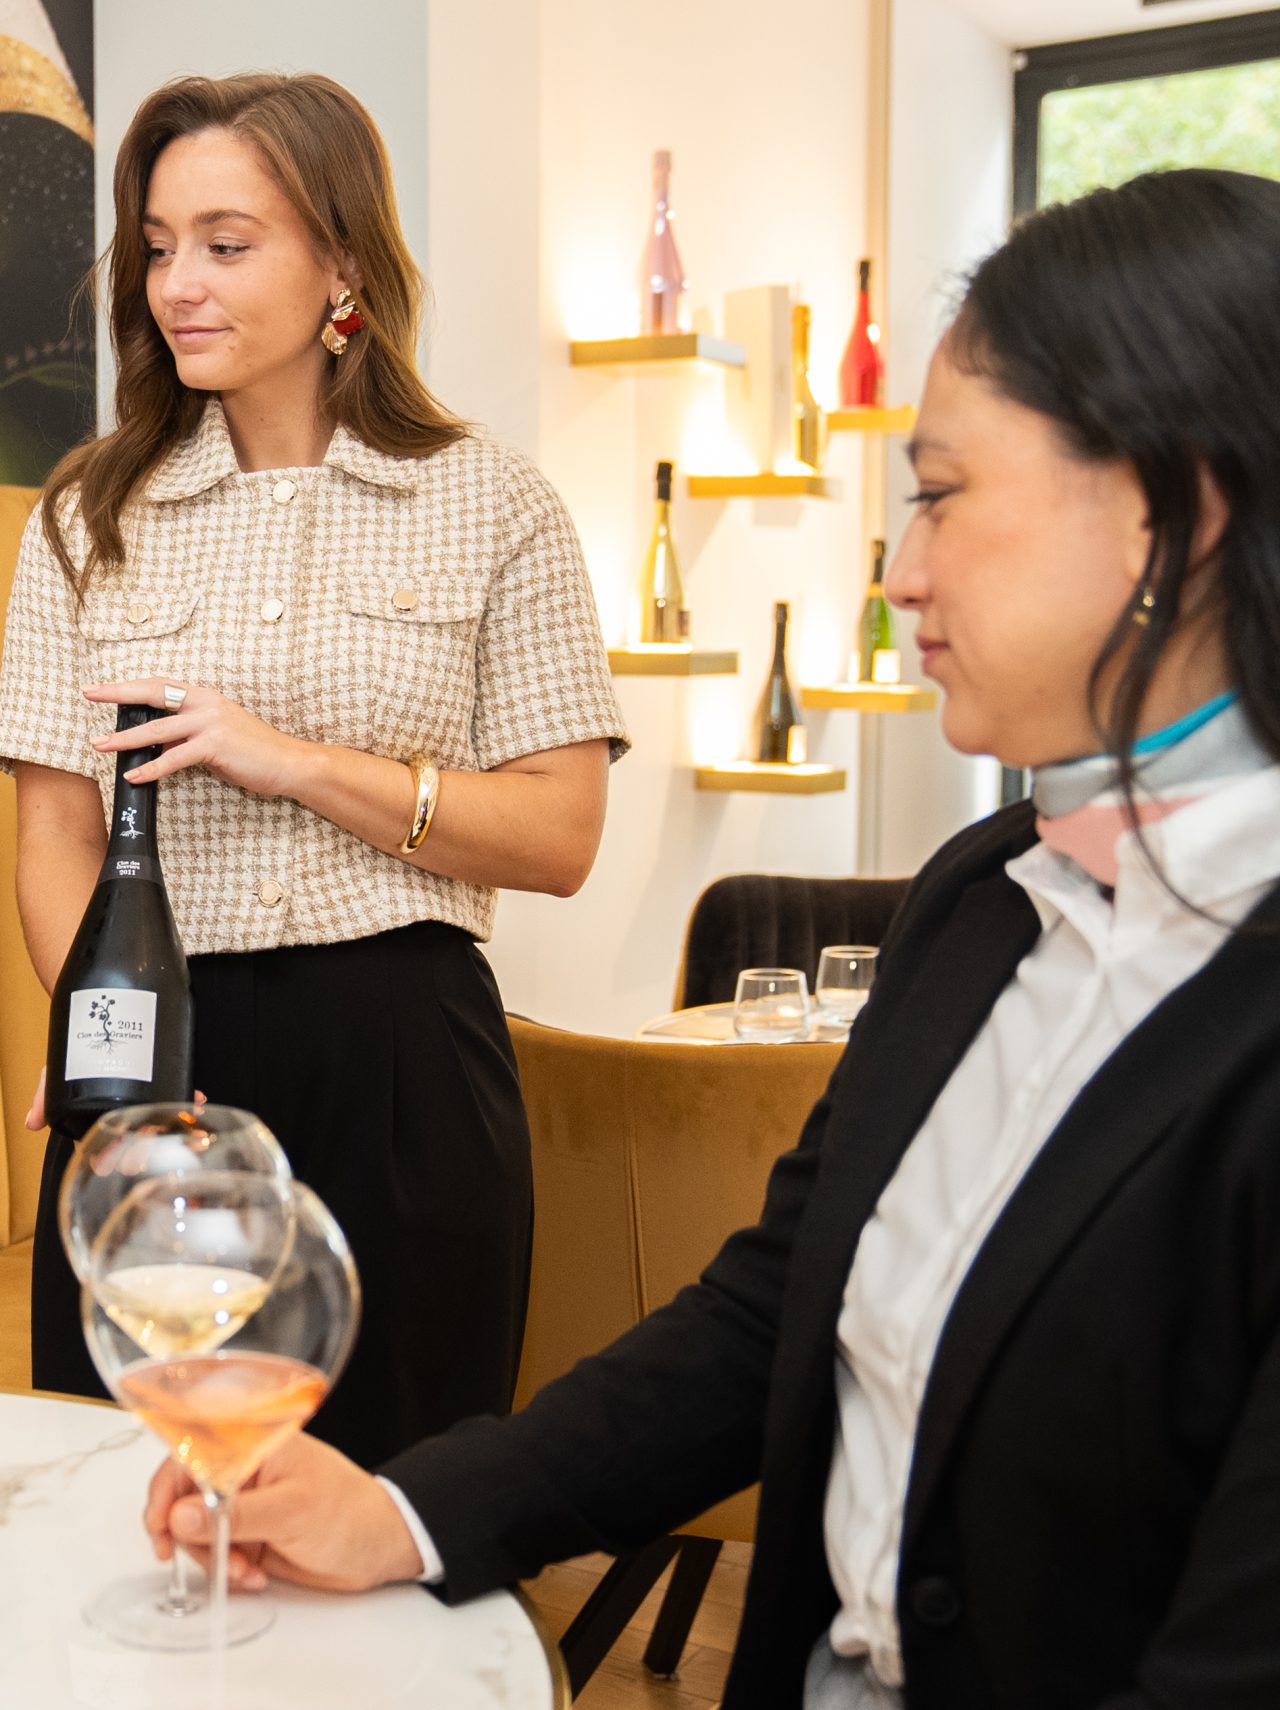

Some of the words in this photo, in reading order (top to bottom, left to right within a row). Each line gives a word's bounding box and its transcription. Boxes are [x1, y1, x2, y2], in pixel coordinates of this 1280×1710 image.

[118, 1020, 143, 1031] 2011
[77, 1031, 92, 1040] Clos
[109, 1031, 143, 1040] Graviers
